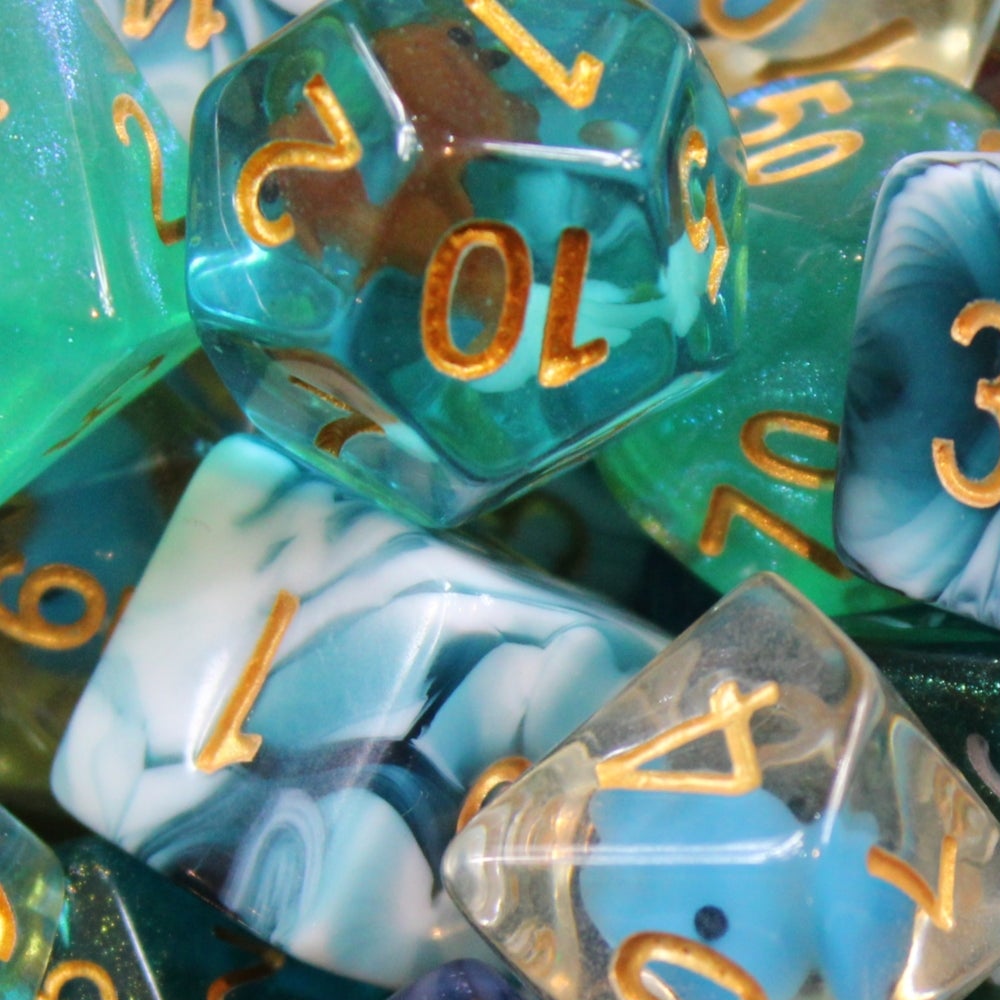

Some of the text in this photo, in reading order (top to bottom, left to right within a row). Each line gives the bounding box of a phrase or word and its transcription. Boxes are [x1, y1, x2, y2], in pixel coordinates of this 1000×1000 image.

[232, 72, 363, 249] 2
[420, 218, 610, 390] 10
[194, 589, 300, 775] 1
[595, 680, 780, 796] 4
